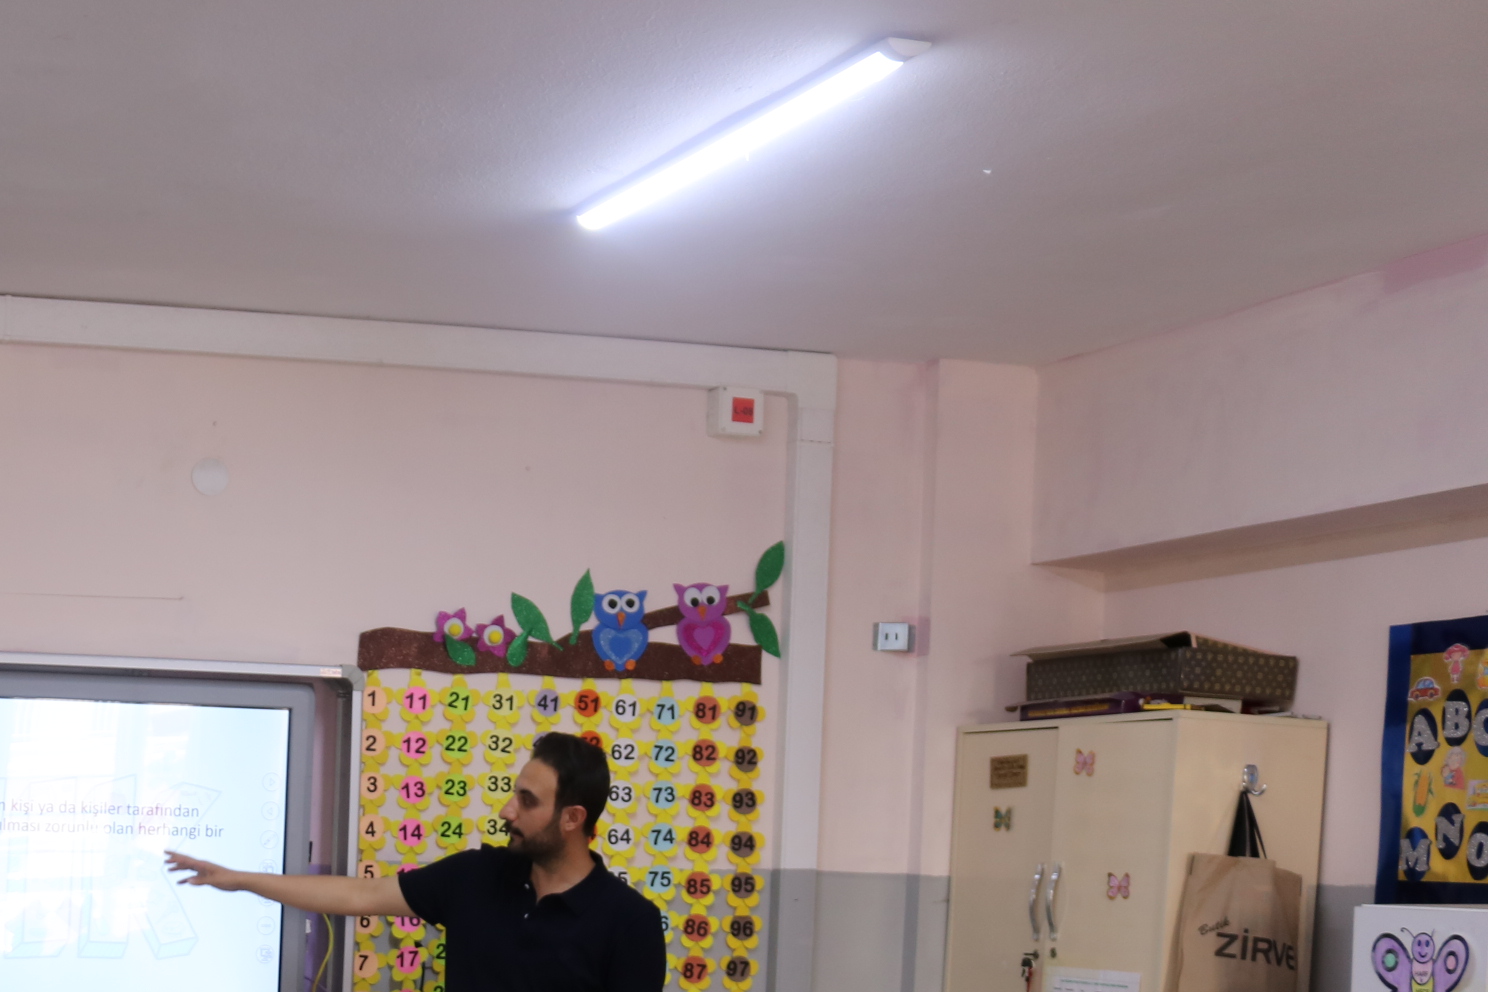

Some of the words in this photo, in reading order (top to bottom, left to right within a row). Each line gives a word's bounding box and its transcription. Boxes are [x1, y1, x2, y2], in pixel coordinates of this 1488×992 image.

[368, 692, 377, 706] 1
[405, 694, 429, 709] 11
[448, 695, 470, 710] 21
[492, 694, 514, 710] 31
[537, 695, 560, 711] 41
[577, 695, 600, 711] 51
[614, 699, 637, 716] 61
[656, 705, 676, 720] 71
[695, 703, 718, 719] 81
[1409, 714, 1439, 751] A
[1443, 700, 1469, 738] B
[365, 735, 376, 751] 2
[402, 737, 426, 753] 12
[445, 736, 468, 751] 22
[488, 736, 512, 752] 32
[612, 744, 635, 760] 62
[653, 745, 676, 761] 72
[692, 744, 716, 760] 82
[367, 777, 378, 793] 3
[401, 782, 425, 797] 13
[444, 779, 467, 795] 23
[653, 787, 675, 802] 73
[692, 792, 715, 808] 83
[38, 803, 54, 815] ya
[59, 801, 75, 813] da
[81, 802, 122, 816] kişiler
[127, 803, 199, 818] tarafından
[138, 823, 200, 839] herhangi
[205, 825, 224, 838] bir
[365, 822, 375, 836] 4
[399, 824, 422, 840] 14
[440, 822, 463, 838] 24
[608, 829, 632, 844] 64
[652, 829, 675, 844] 74
[688, 831, 712, 847] 84
[1400, 838, 1431, 871] M
[1436, 813, 1464, 849] N
[649, 871, 671, 887] 75
[687, 878, 711, 894] 85
[359, 956, 368, 971] 7
[396, 952, 419, 968] 17
[1214, 928, 1295, 971] ZİRVE
